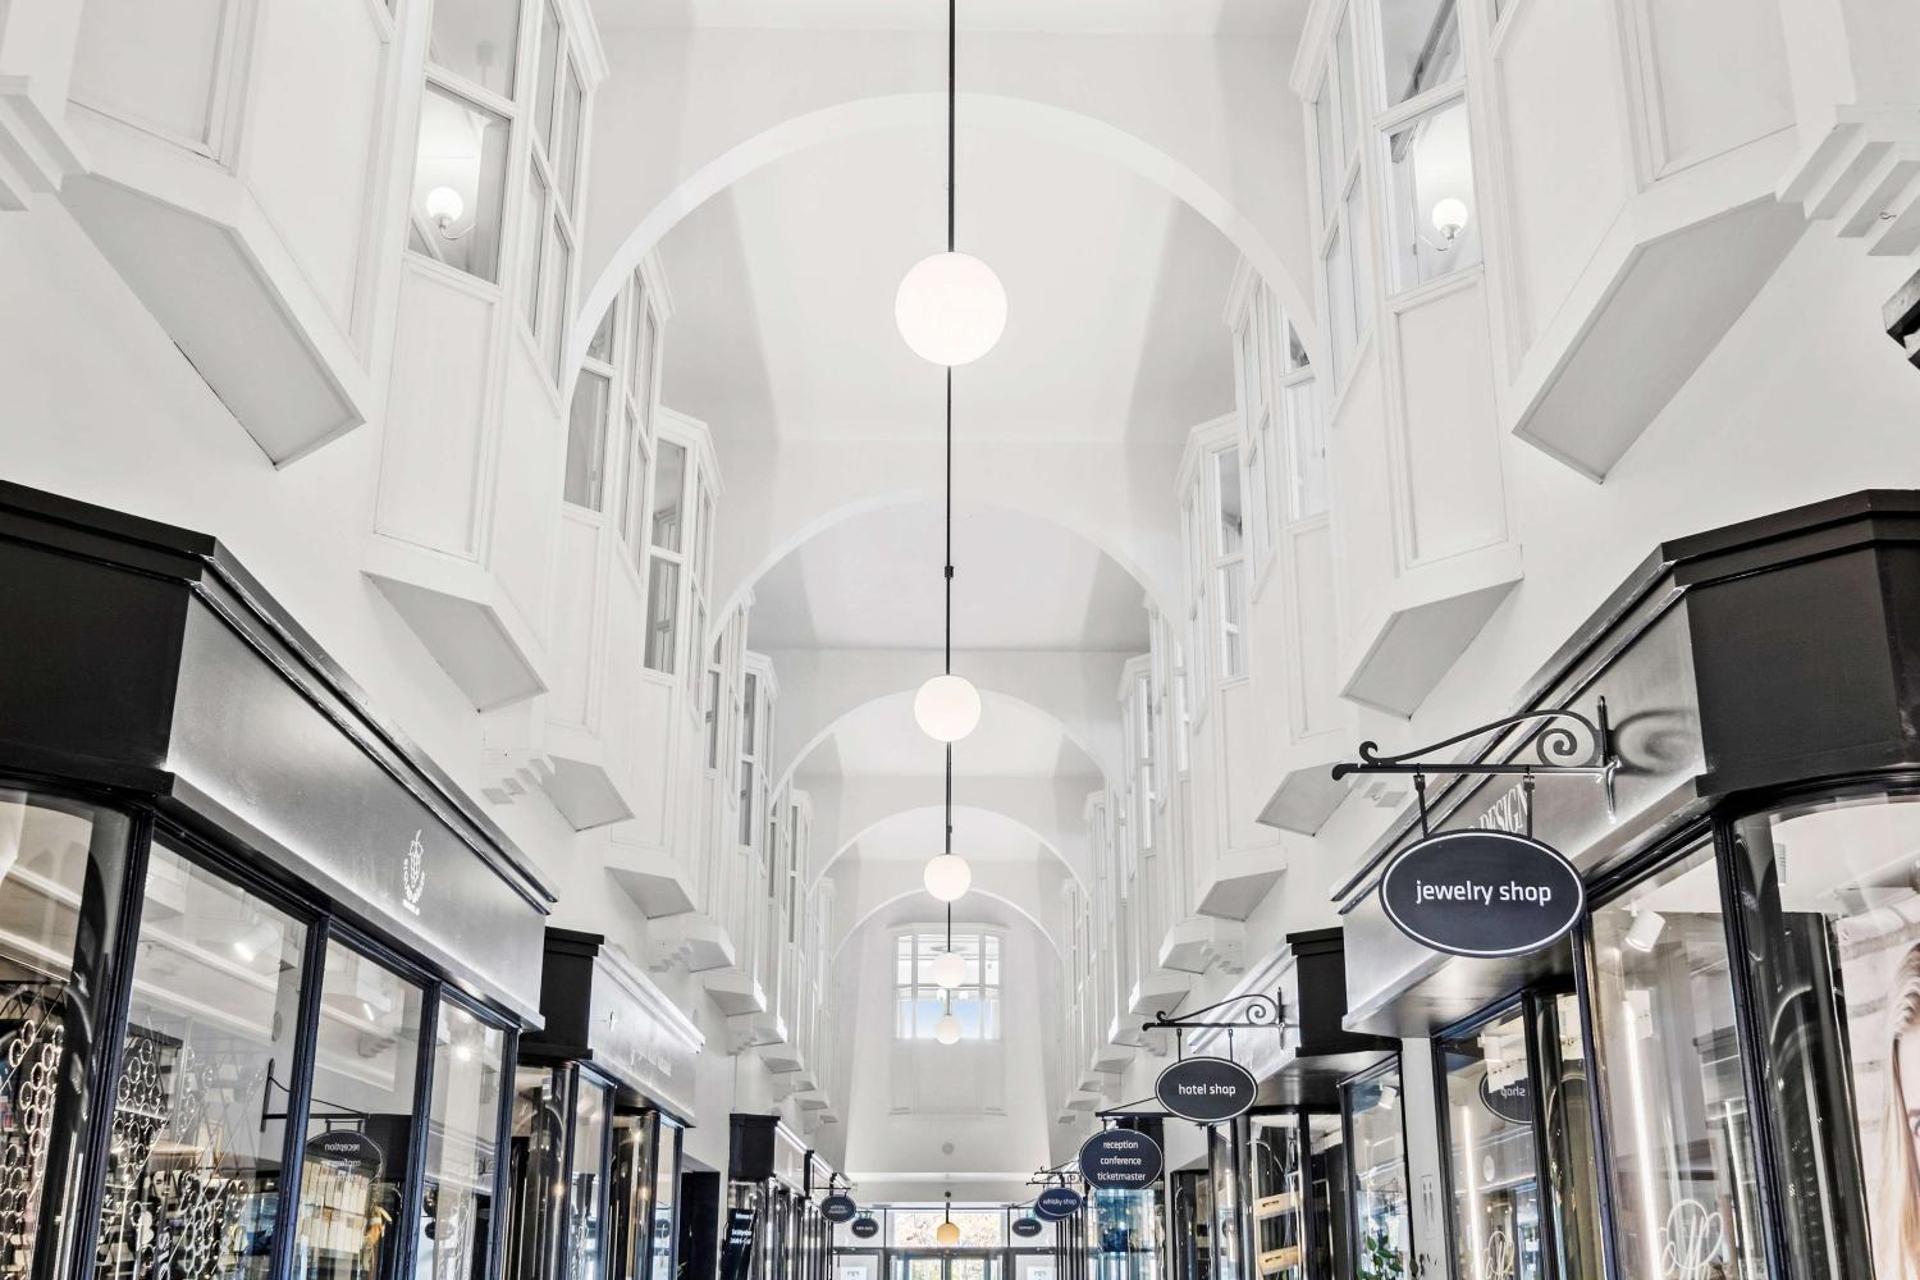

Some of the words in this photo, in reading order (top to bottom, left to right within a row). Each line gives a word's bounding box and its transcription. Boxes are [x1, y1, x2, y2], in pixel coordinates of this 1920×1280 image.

[1416, 880, 1493, 905] jewelry
[1499, 881, 1552, 907] shop
[1178, 1083, 1206, 1096] hotel
[1209, 1083, 1237, 1098] shop
[1102, 1140, 1139, 1151] reception
[1099, 1155, 1142, 1166] conference
[1096, 1172, 1147, 1181] ticketmaster
[1042, 1198, 1062, 1207] whisky
[1063, 1198, 1078, 1206] shop
